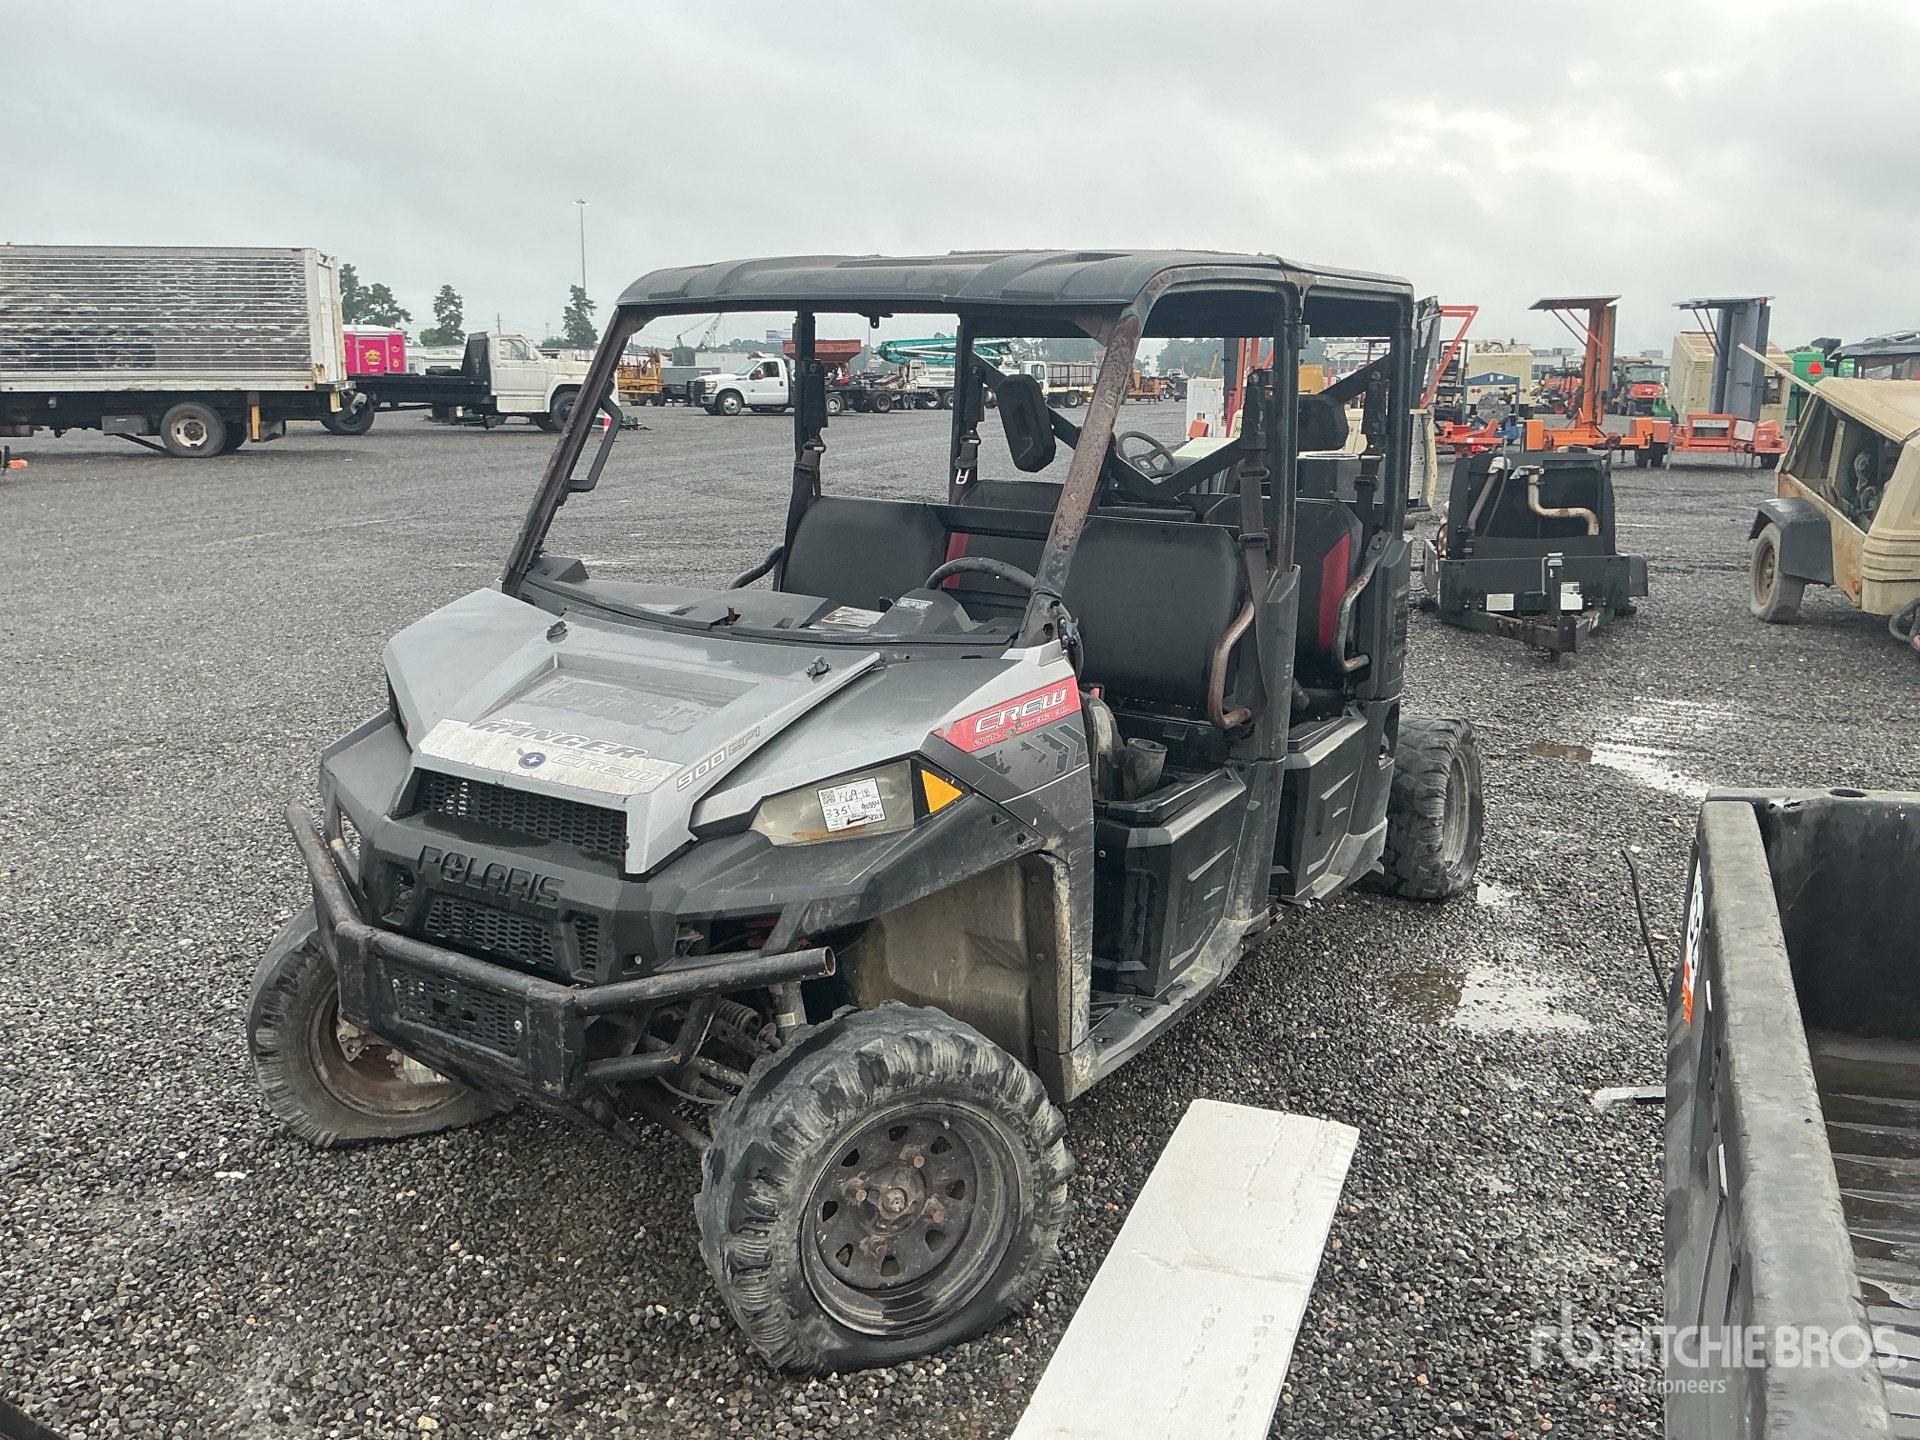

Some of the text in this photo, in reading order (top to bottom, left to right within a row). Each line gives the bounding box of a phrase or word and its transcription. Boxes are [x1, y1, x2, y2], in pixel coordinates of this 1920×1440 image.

[974, 686, 1069, 735] CREW
[470, 720, 649, 759] RANGER
[551, 753, 662, 783] CREW
[677, 746, 726, 793] 900
[417, 845, 566, 908] POLARIS
